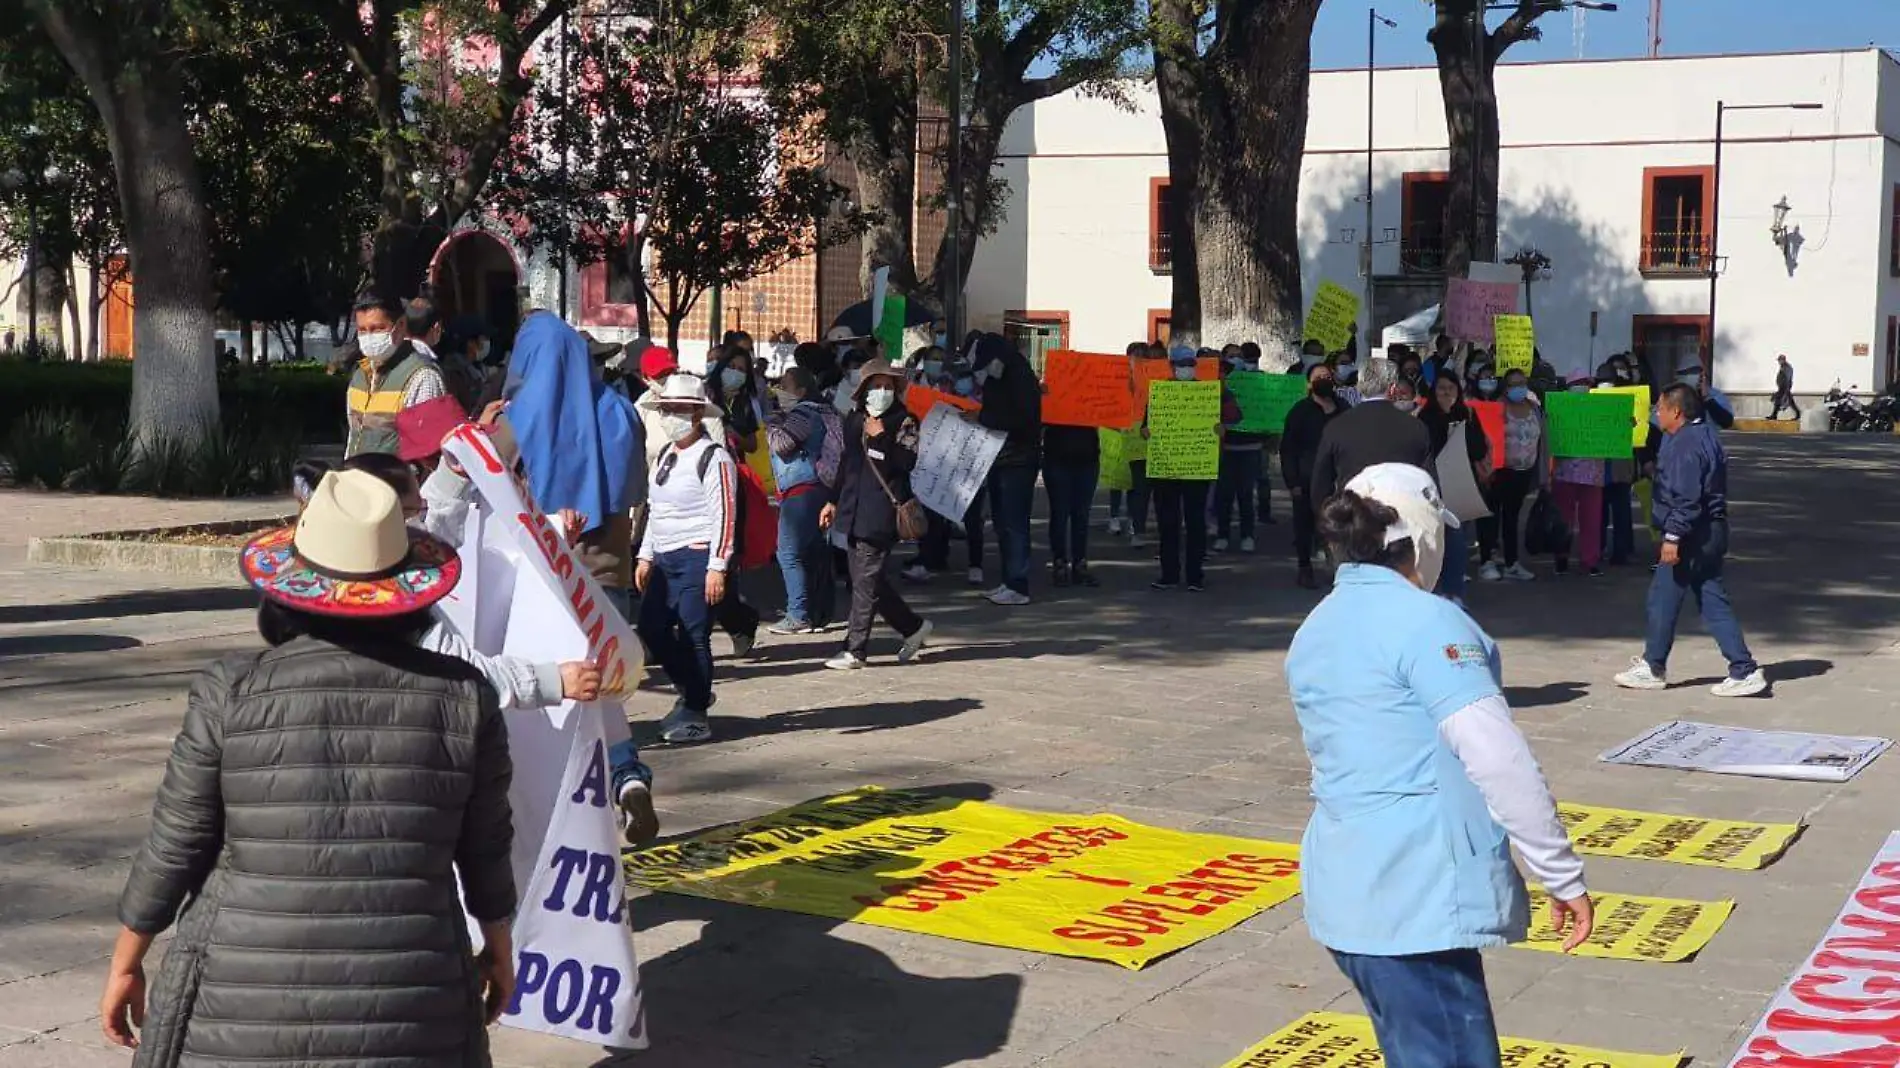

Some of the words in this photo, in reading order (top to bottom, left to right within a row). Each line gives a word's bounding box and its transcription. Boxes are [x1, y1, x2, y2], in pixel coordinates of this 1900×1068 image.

[572, 738, 607, 808] A
[1045, 869, 1133, 887] Y
[506, 950, 621, 1036] POR
